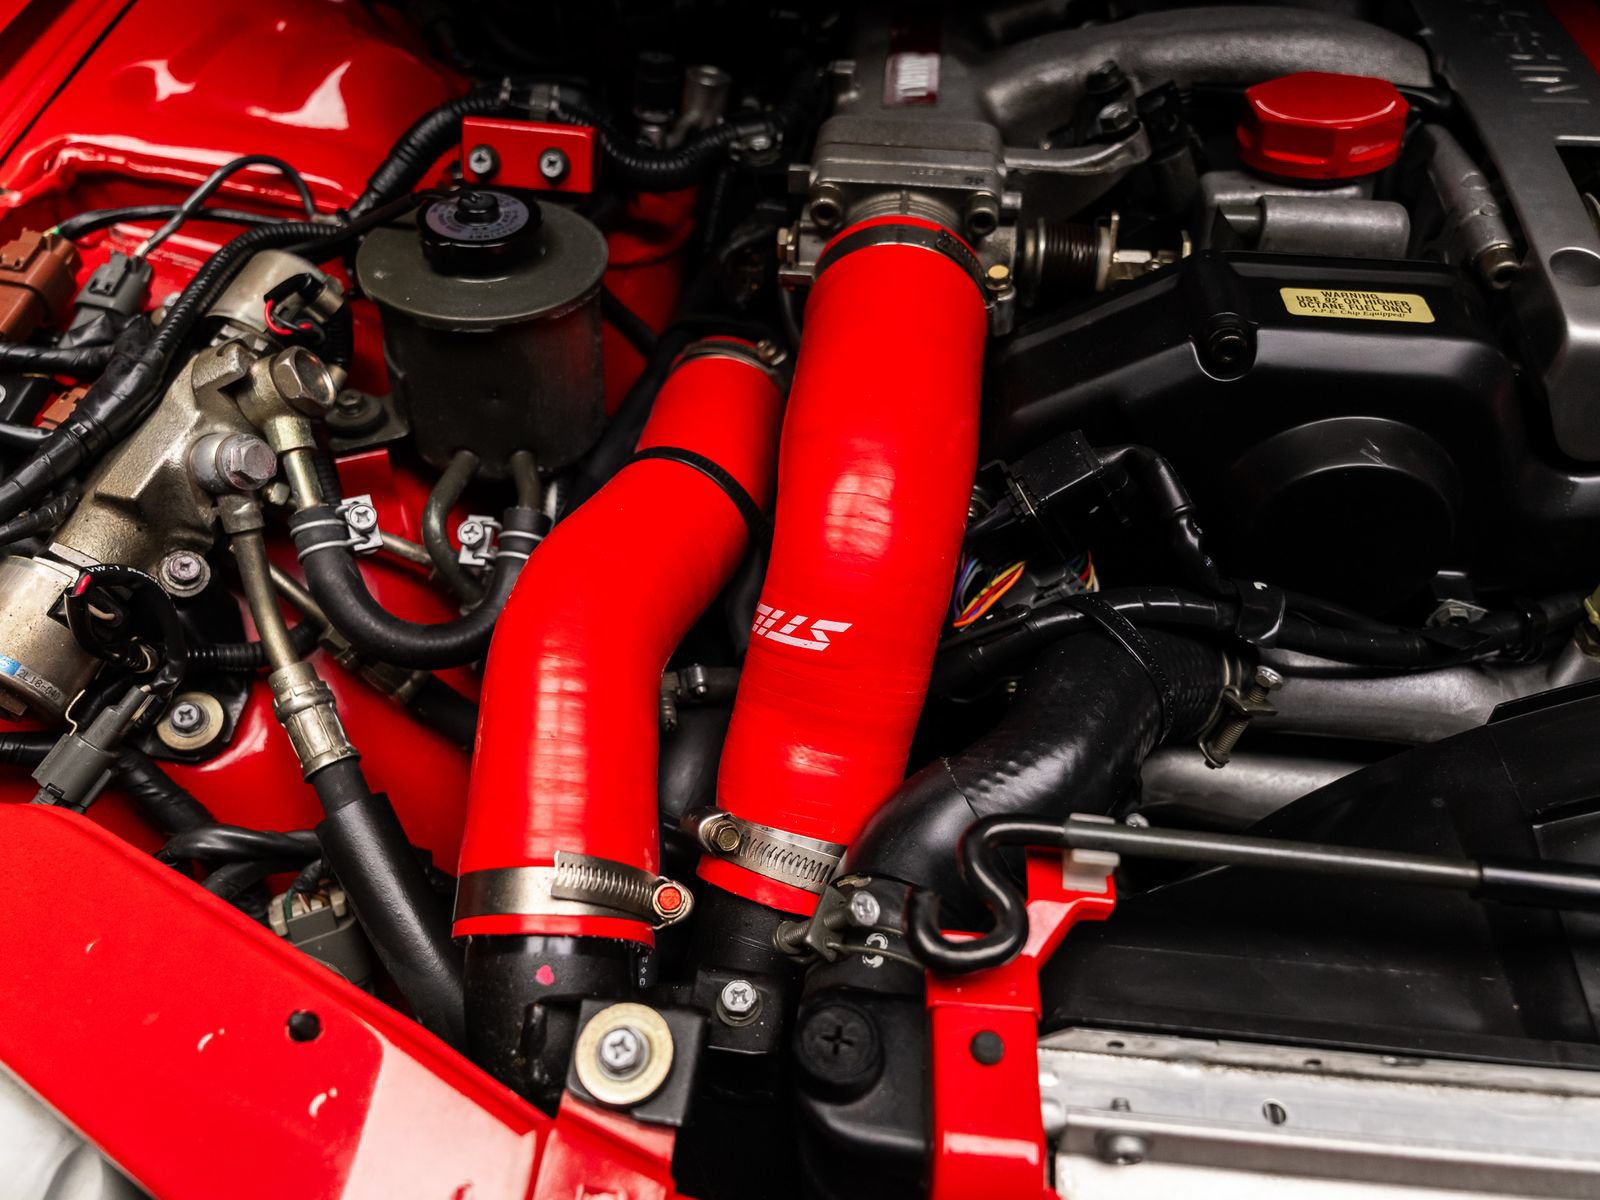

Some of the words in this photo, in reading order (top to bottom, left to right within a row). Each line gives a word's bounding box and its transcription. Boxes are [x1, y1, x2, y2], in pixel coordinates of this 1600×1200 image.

[1321, 291, 1379, 299] WARNING
[1296, 295, 1320, 303] USE
[1363, 299, 1410, 308] HIGHER
[1298, 301, 1345, 310] OCTANE
[1349, 303, 1379, 312] FUEL
[1382, 305, 1412, 314] ONLY
[1340, 309, 1361, 317] Chip
